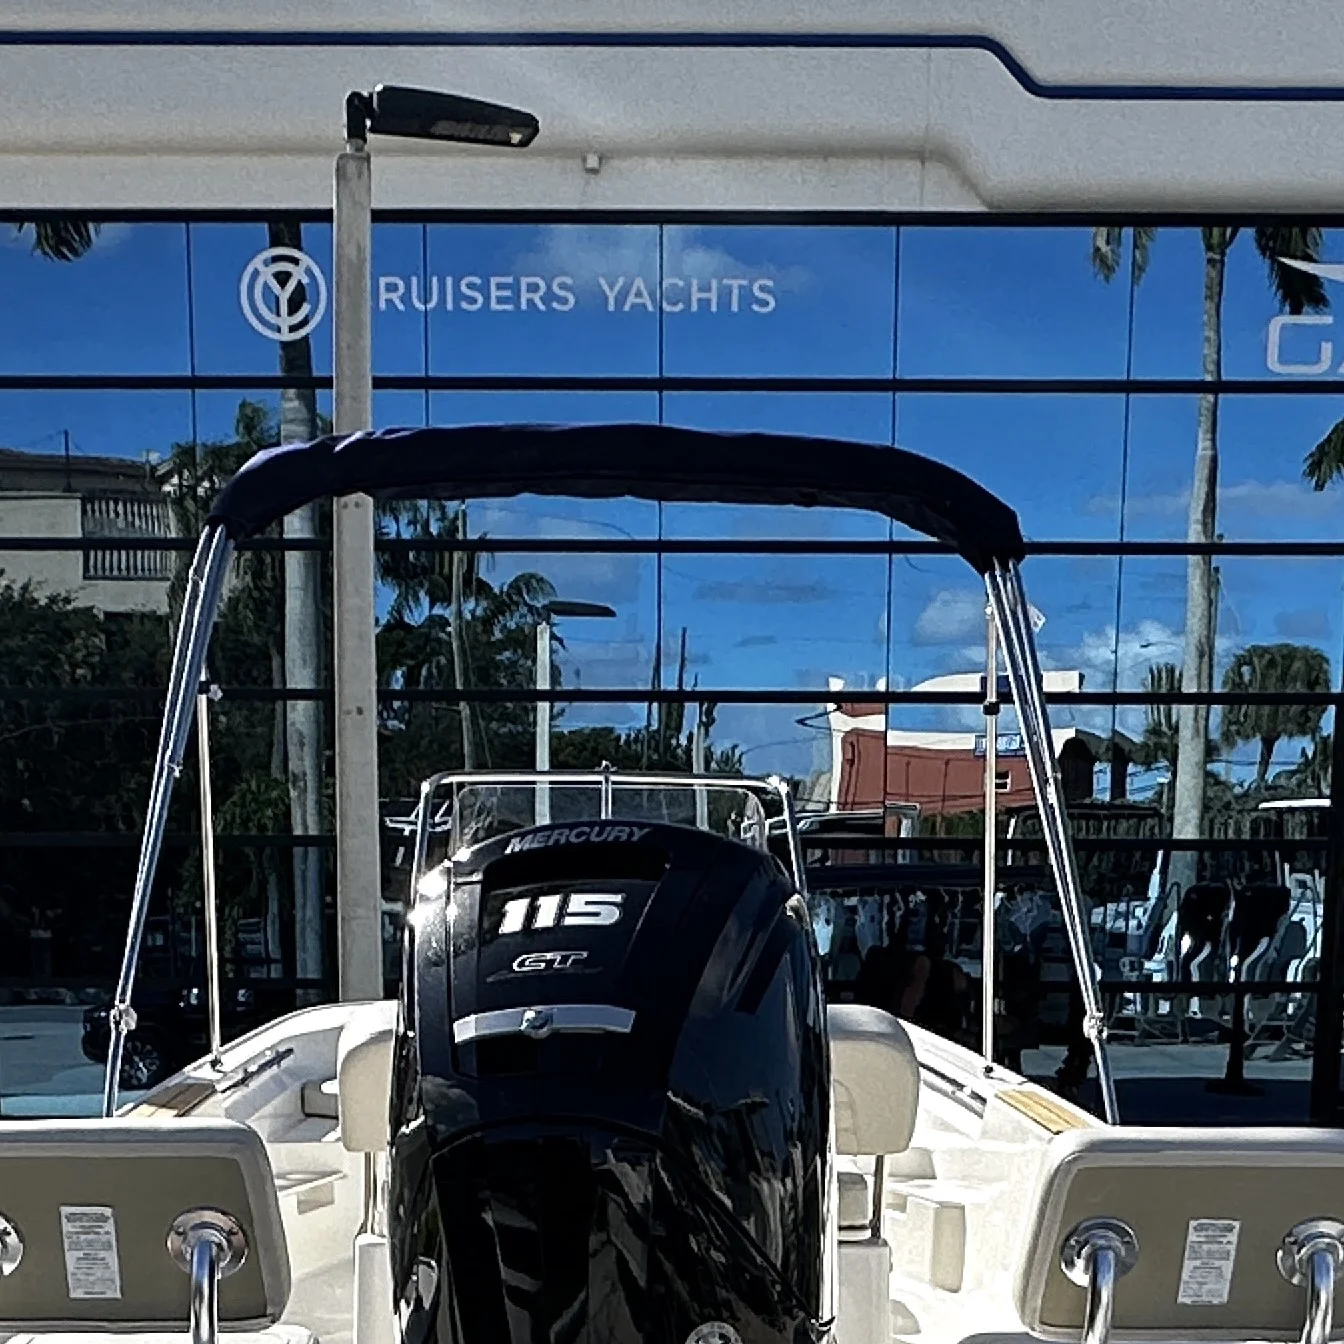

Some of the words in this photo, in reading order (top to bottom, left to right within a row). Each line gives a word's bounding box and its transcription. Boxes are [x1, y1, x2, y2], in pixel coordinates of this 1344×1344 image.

[378, 275, 576, 313] RUISERS
[600, 275, 777, 314] YACHTS
[504, 826, 651, 855] MERCURY
[498, 892, 626, 935] 115
[512, 951, 589, 972] GT
